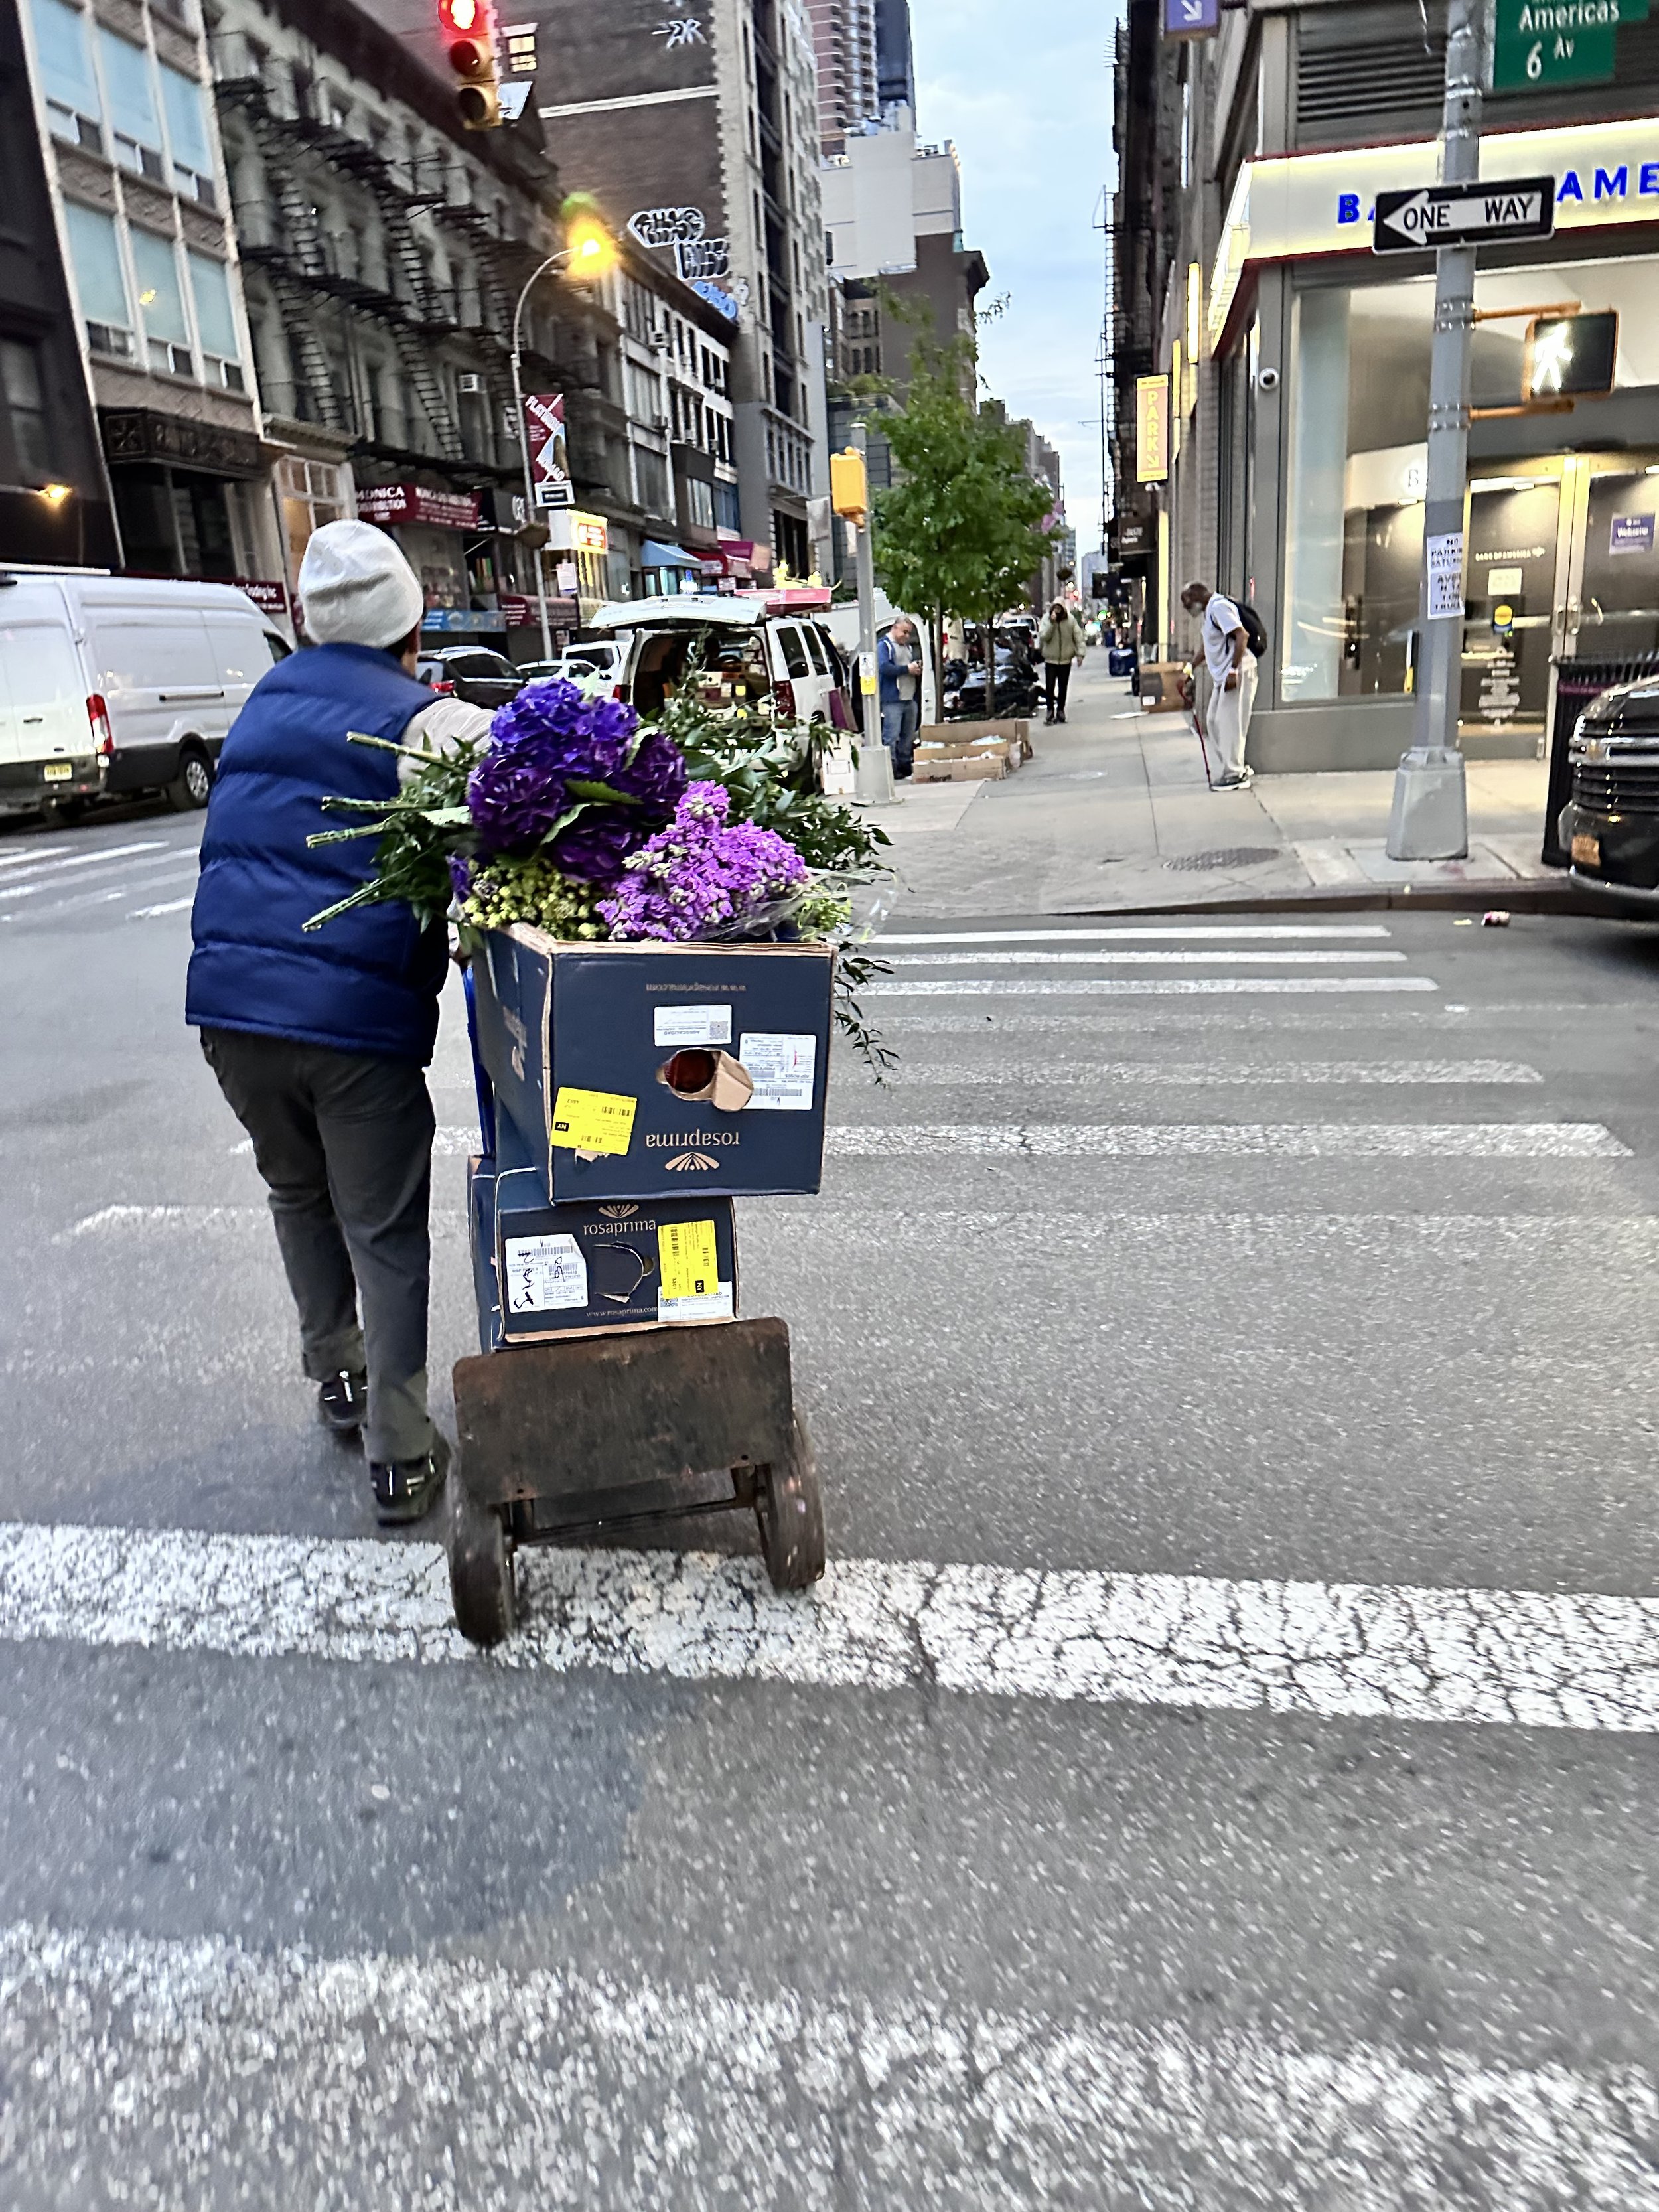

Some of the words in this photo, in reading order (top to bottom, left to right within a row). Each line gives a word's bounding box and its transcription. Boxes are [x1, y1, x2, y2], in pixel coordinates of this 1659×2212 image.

[1519, 0, 1620, 31] Americas
[1527, 40, 1542, 80] 6
[1553, 33, 1575, 60] Av
[1403, 204, 1451, 230] ONE
[1484, 194, 1534, 223] WAY
[1146, 390, 1159, 452] PARK
[646, 1129, 740, 1147] rosaprima
[583, 1220, 656, 1236] rosaprima
[697, 1282, 703, 1291] NY
[586, 1305, 658, 1317] www.rosaprima.com
